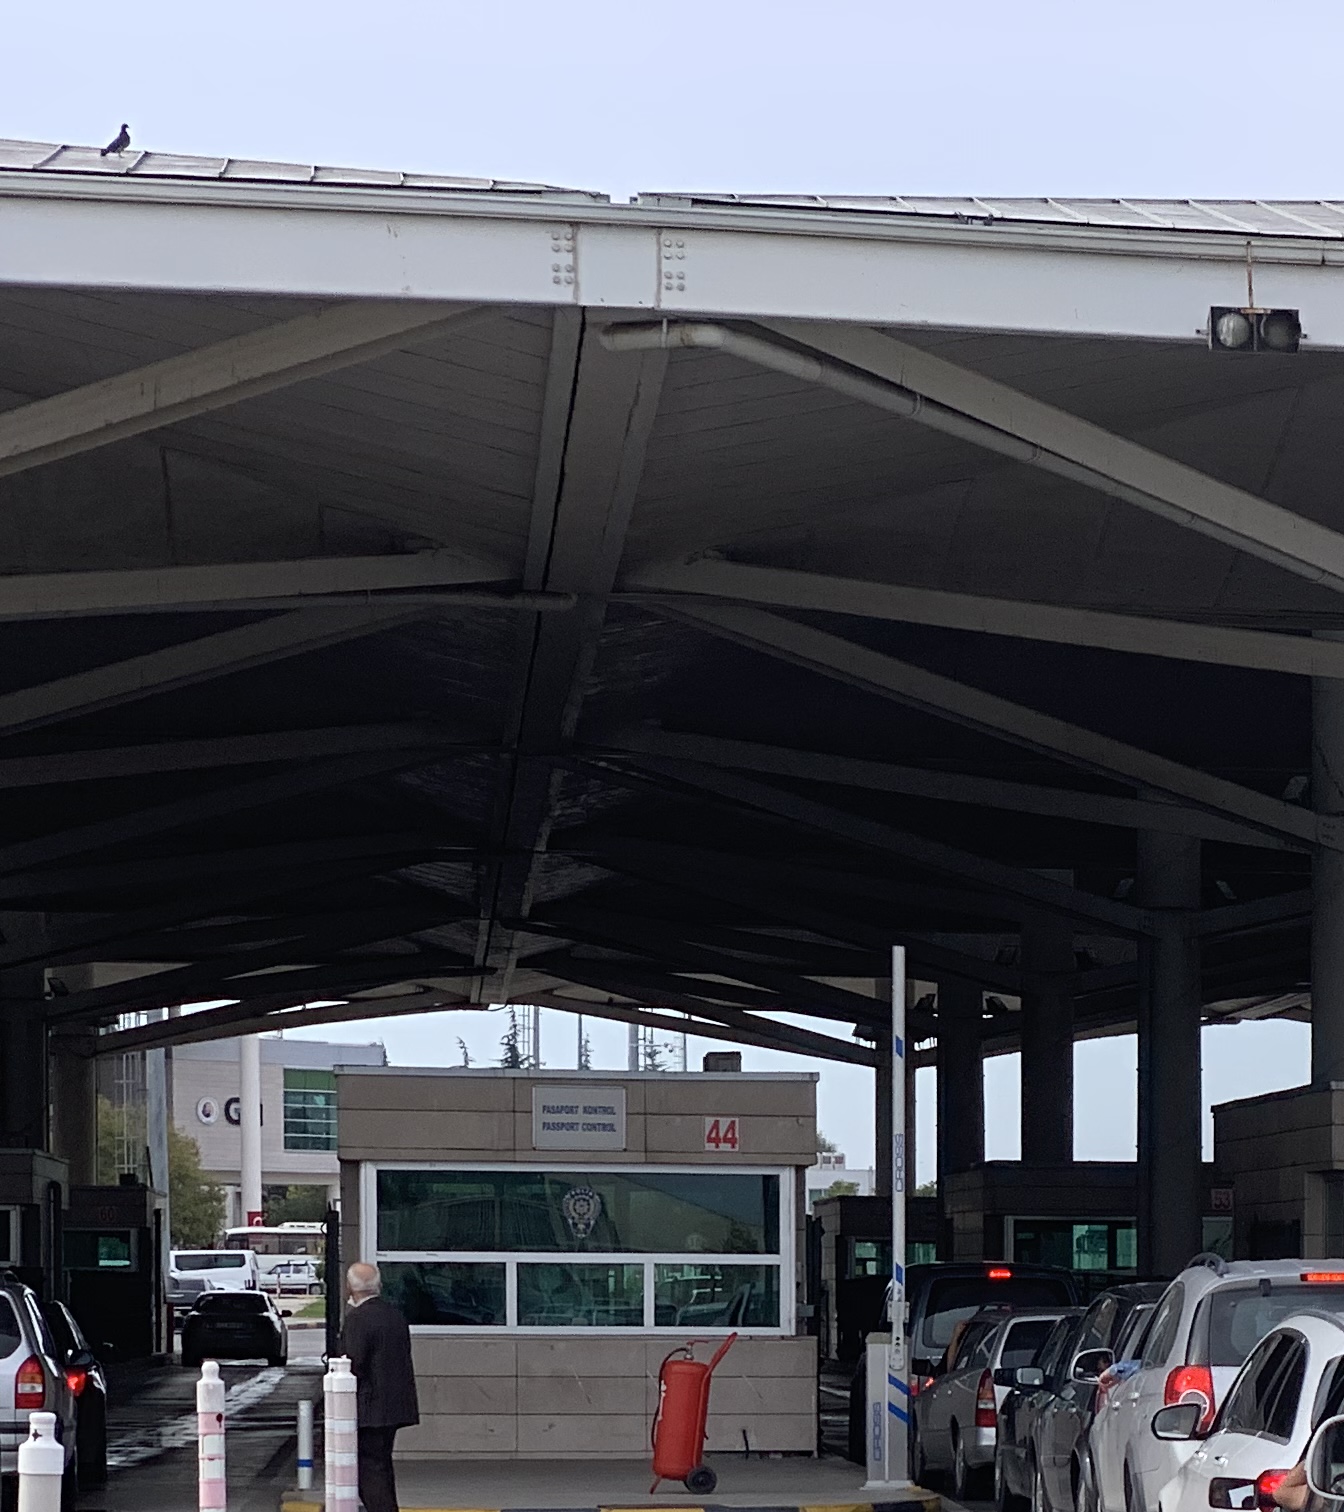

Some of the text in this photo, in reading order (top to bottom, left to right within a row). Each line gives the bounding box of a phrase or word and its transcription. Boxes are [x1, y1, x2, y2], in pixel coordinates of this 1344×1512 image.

[542, 1104, 616, 1115] PASAPORT KONTROL
[542, 1121, 616, 1132] PASSPORT CONTROL
[706, 1119, 738, 1149] 44
[895, 1133, 904, 1192] CROSS
[872, 1402, 882, 1461] CROSS
